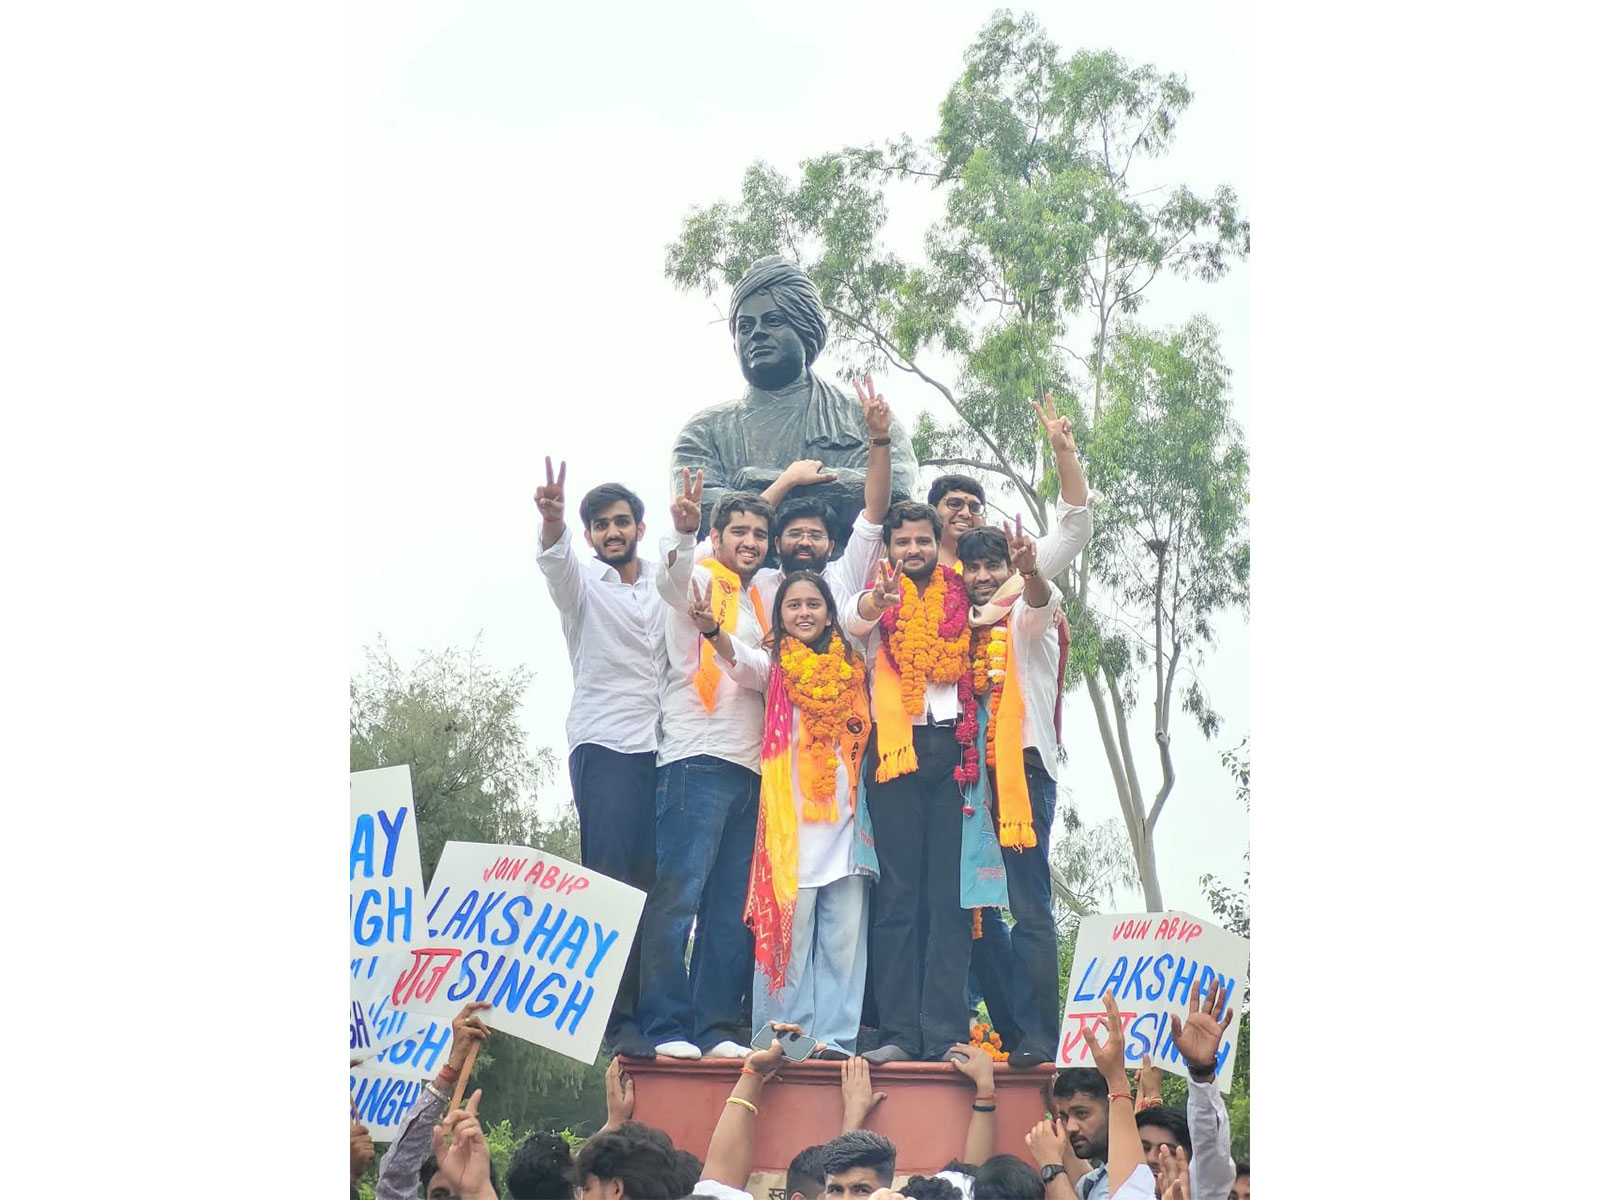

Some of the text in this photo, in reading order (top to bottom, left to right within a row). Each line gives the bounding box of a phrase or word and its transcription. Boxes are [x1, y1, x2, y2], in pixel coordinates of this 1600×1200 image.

[483, 857, 590, 895] JOIN ABVP
[427, 887, 619, 979] LAKSHAY
[1112, 917, 1203, 943] JOIN ABVP
[447, 949, 595, 1036] SINGH
[1073, 953, 1236, 1023] LAKSHAY
